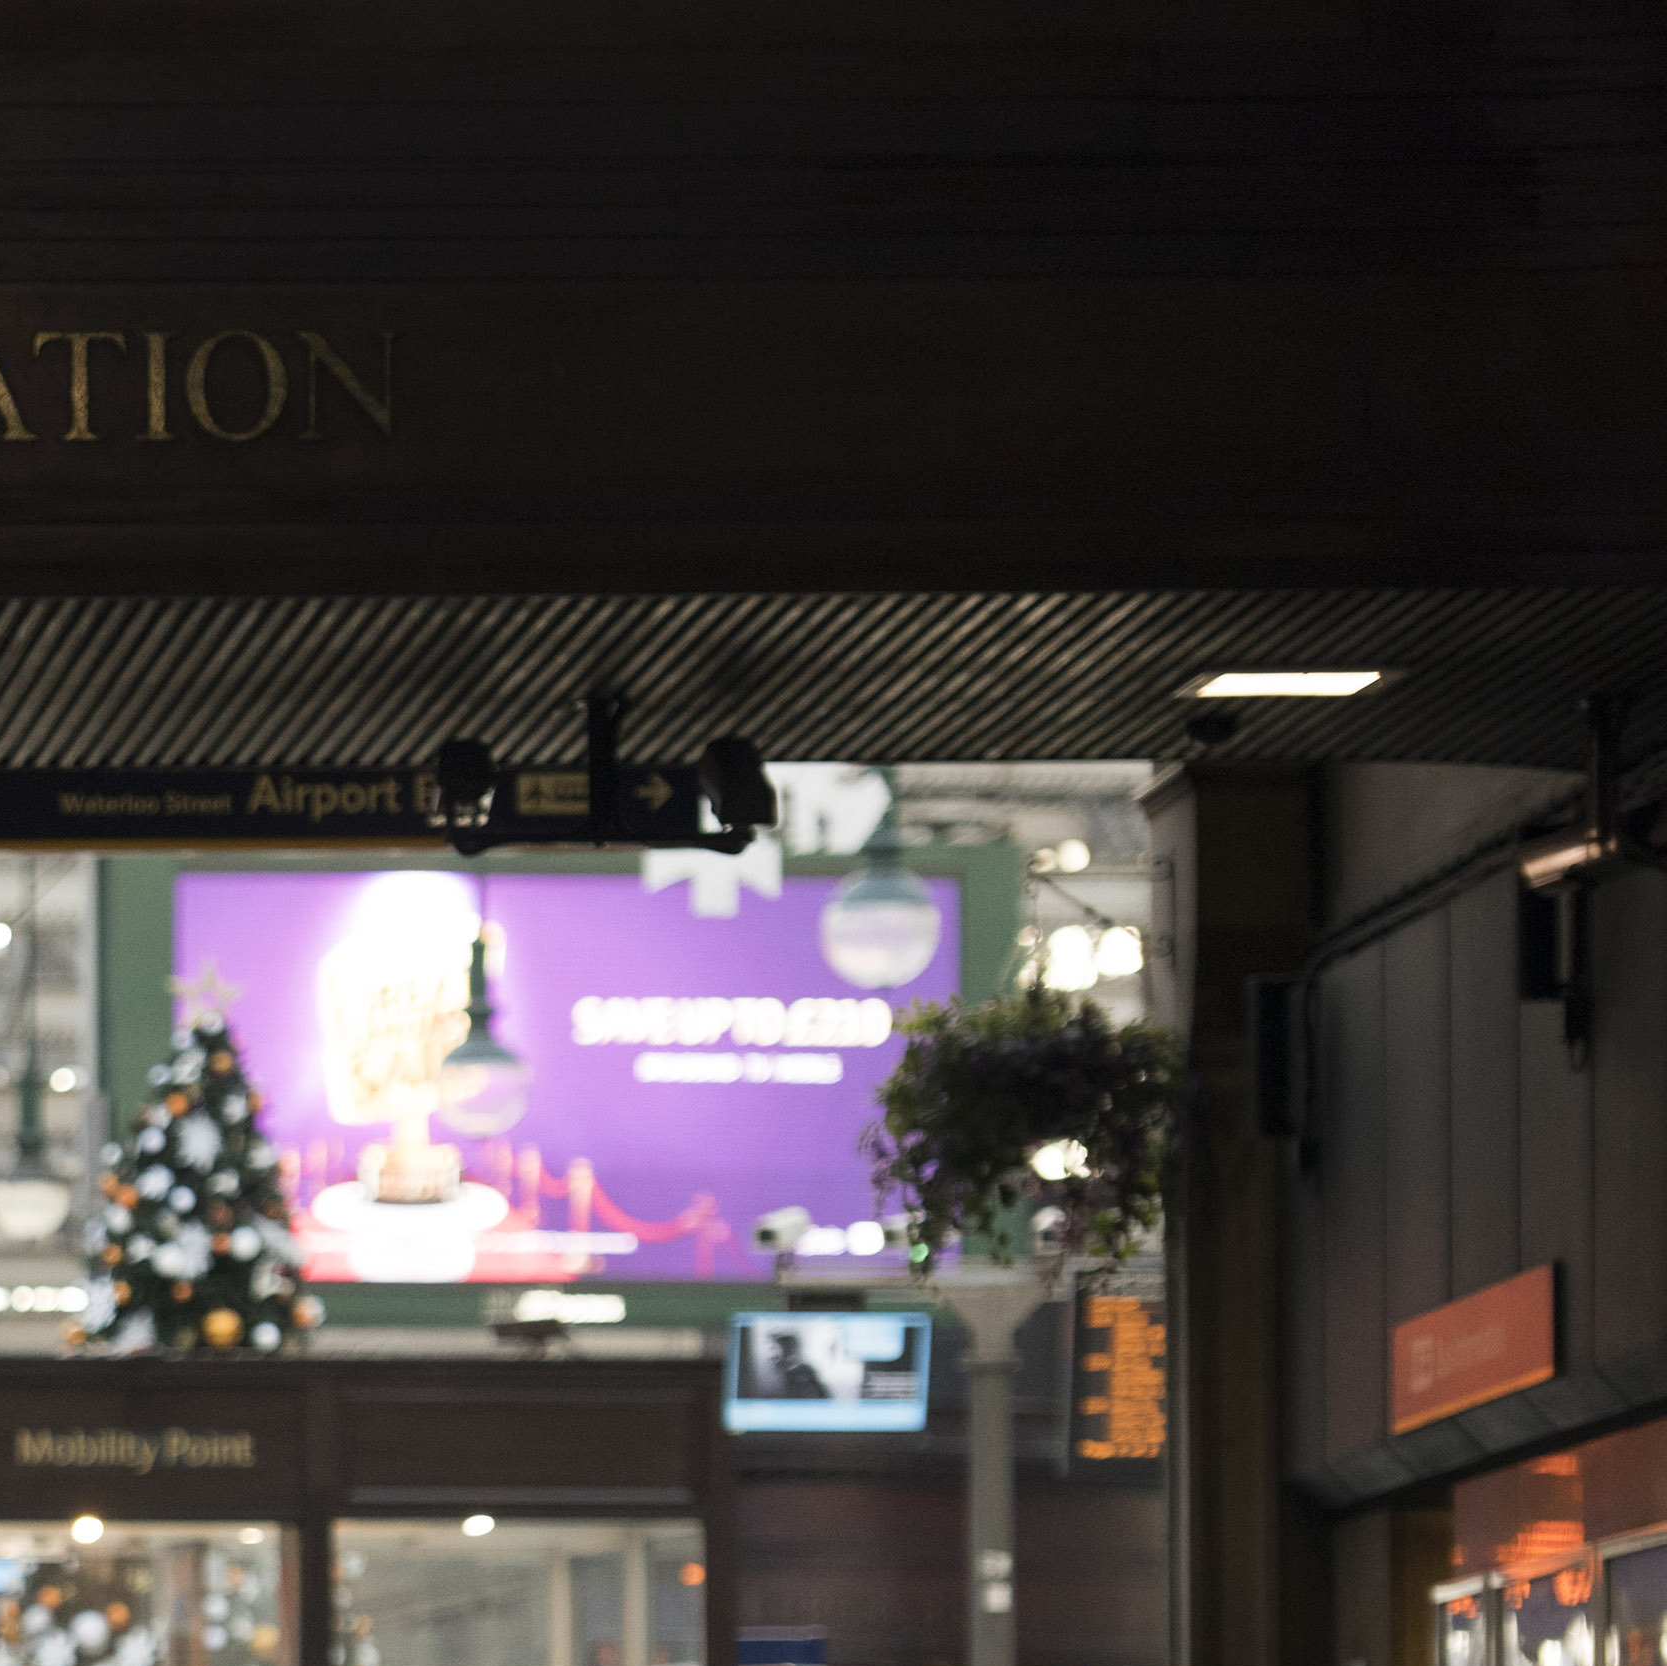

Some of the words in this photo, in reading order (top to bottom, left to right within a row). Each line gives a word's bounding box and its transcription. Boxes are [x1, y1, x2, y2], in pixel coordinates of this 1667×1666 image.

[247, 772, 403, 823] Airport
[15, 1427, 160, 1476] Mobility
[162, 1428, 257, 1468] Point
